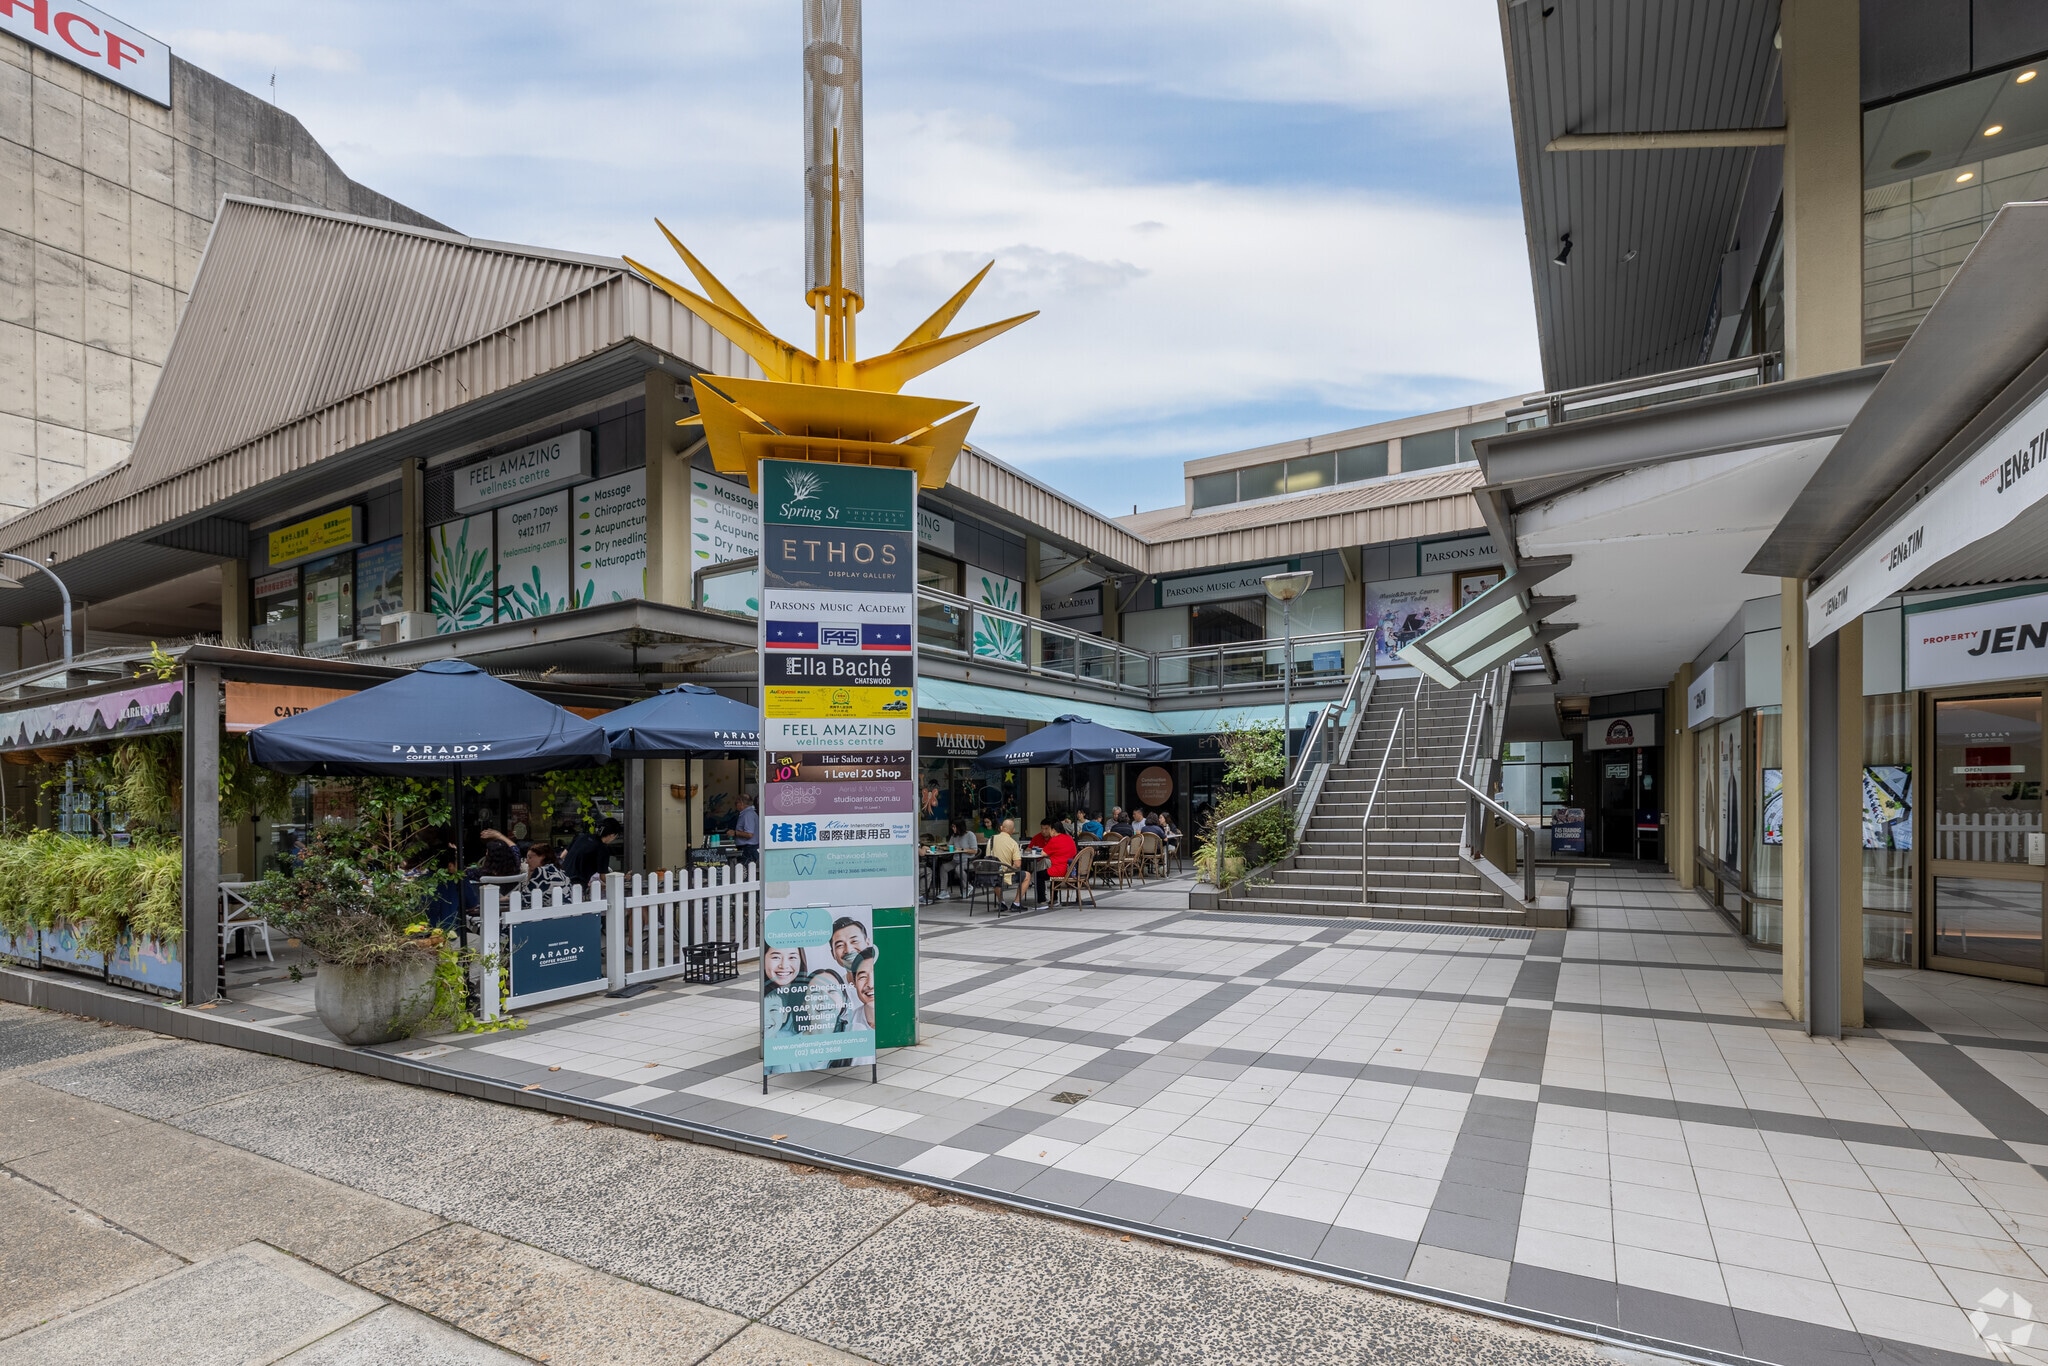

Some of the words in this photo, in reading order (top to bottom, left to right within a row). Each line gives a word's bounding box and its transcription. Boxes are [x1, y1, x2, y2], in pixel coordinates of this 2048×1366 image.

[0, 0, 145, 70] HCF
[469, 466, 496, 486] FEEL
[499, 443, 561, 477] AMAZING
[479, 478, 517, 497] wellness
[519, 468, 550, 485] centre
[594, 483, 632, 501] Massage
[714, 485, 759, 510] Massage
[512, 511, 532, 525] Open
[533, 508, 538, 518] 7
[539, 504, 559, 516] Days
[779, 502, 823, 521] Spring
[825, 505, 840, 520] St
[917, 512, 940, 532] ING
[517, 525, 535, 539] 9412
[536, 522, 551, 534] 1177
[503, 537, 568, 559] feelamazing.com.au
[594, 540, 610, 552] Dry
[714, 536, 733, 553] Dry
[1888, 525, 1924, 571] JEN&TIM
[782, 539, 896, 565] ETHOS
[1425, 547, 1475, 563] PARSONS
[828, 570, 861, 578] DISPLAY
[862, 572, 896, 580] GALLERY
[1166, 585, 1204, 598] PARSONS
[1206, 580, 1236, 592] MUSIC
[770, 600, 816, 611] PARSONS
[820, 602, 853, 612] MUSIC
[857, 603, 907, 614] ACADEMY
[1058, 598, 1096, 609] ACADEMY
[820, 627, 860, 646] F45
[1923, 631, 1978, 645] PROPERTY
[1967, 621, 2048, 657] JEN
[792, 657, 827, 676] Ella
[832, 657, 892, 677] Baché
[854, 677, 892, 685] CHATSWOOD
[783, 724, 818, 736] FEEL
[823, 724, 896, 736] AMAZING
[796, 737, 844, 746] wellness
[848, 737, 884, 746] centre
[936, 732, 986, 750] MARKUS
[392, 743, 492, 754] PARADOX
[1005, 751, 1035, 759] PARADOX
[822, 755, 840, 764] Hair
[841, 755, 863, 764] Salon
[772, 763, 801, 782] JOY
[824, 770, 829, 778] 1
[832, 769, 859, 778] Level
[861, 769, 874, 778] 20
[875, 769, 902, 780] Shop
[794, 785, 822, 796] studio
[880, 785, 896, 793] Yoga
[794, 795, 816, 804] arise
[769, 821, 817, 843] 佳源
[819, 829, 891, 841] 國際健康用品
[826, 852, 866, 860] Chatswood
[767, 929, 807, 940] Chatswood
[808, 928, 831, 937] Smiles
[531, 945, 585, 961] PARADOX
[776, 987, 790, 995] NO
[791, 985, 808, 993] GAP
[809, 983, 837, 992] Check
[804, 993, 829, 1002] Clean
[793, 1004, 810, 1012] GAP
[811, 1001, 854, 1011] Whitening
[795, 1013, 836, 1022] Invisalign
[798, 1022, 836, 1032] Implants
[794, 1049, 808, 1057] (02)
